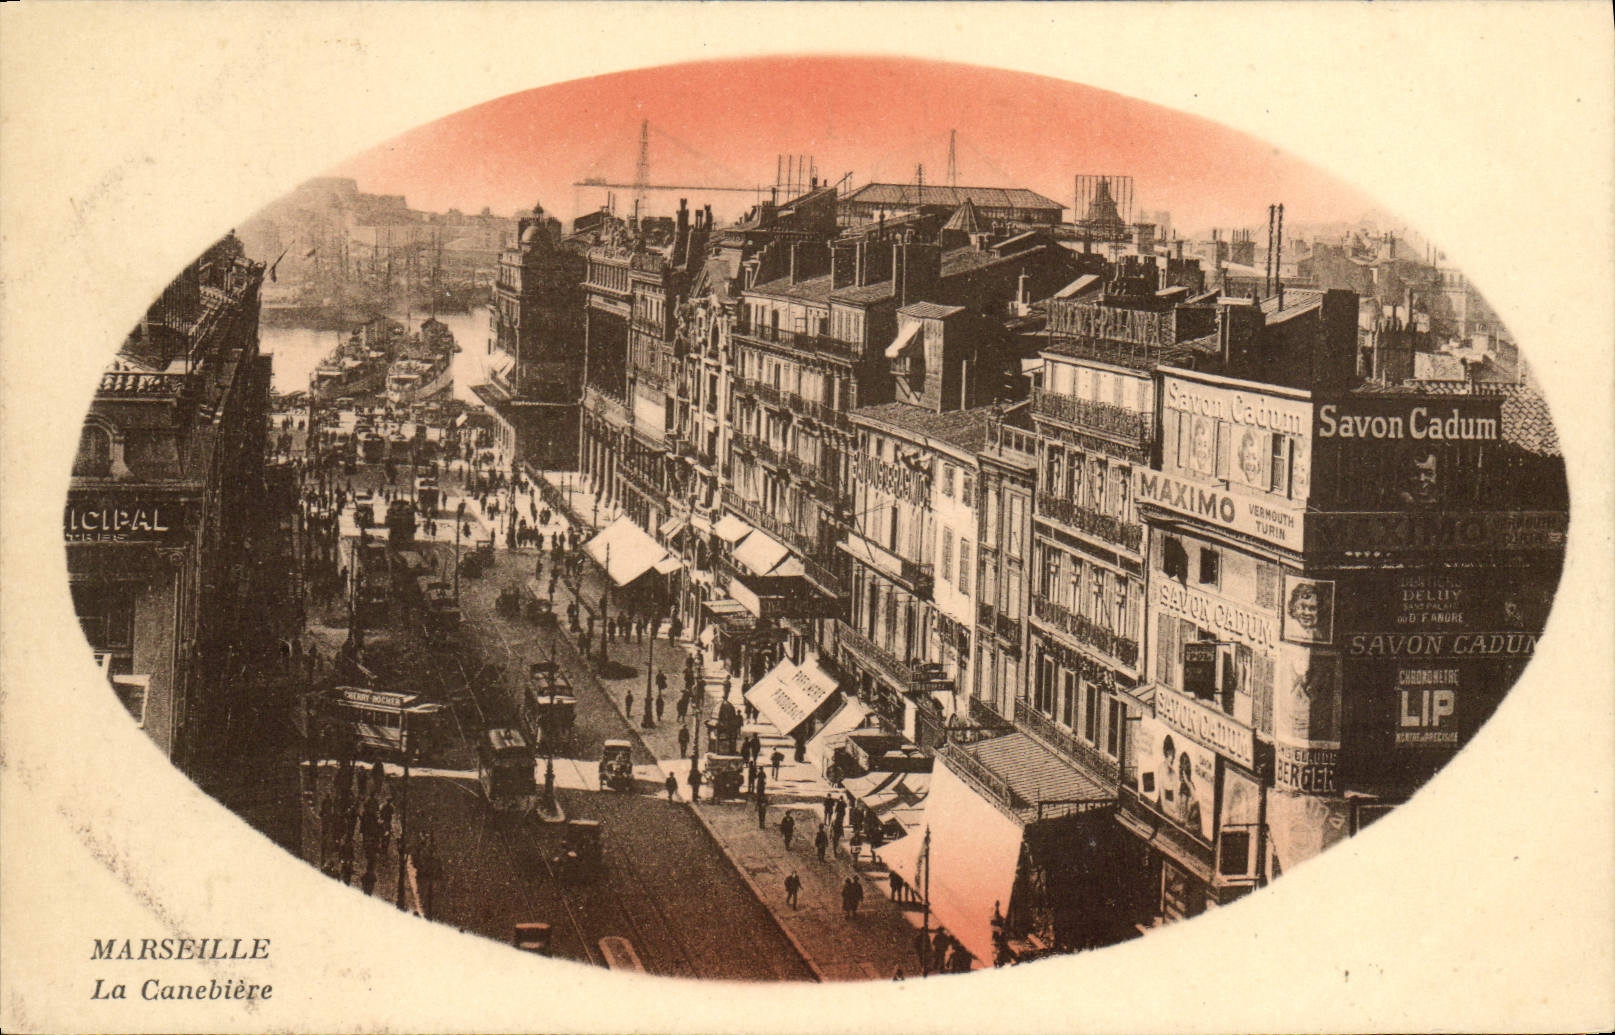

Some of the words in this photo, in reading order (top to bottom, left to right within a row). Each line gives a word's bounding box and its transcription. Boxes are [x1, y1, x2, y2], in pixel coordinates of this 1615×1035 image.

[1168, 382, 1224, 420] Savon
[1231, 395, 1304, 437] Cadum
[1319, 404, 1404, 439] Savon
[1409, 406, 1498, 440] Cadum
[1140, 471, 1235, 524] MAXIMO
[71, 508, 169, 532] ICIPAL
[1249, 503, 1294, 528] VERMOUTH
[1256, 520, 1286, 541] TURIN
[1159, 583, 1210, 628] SAVON
[1213, 602, 1275, 657] CADUM
[1350, 634, 1443, 655] SAVON
[1400, 689, 1455, 727] LIP
[1277, 758, 1337, 792] BERGER
